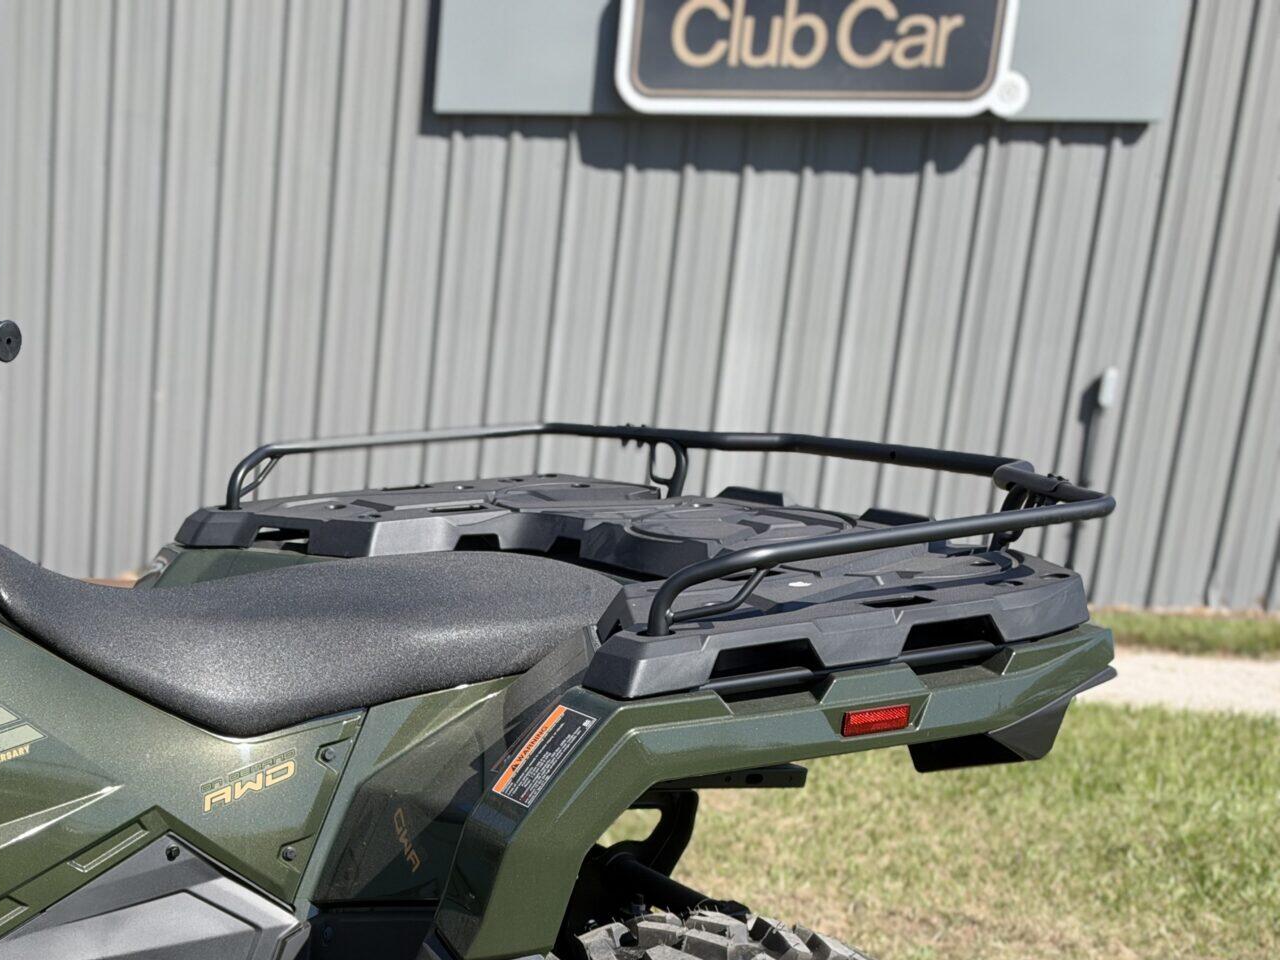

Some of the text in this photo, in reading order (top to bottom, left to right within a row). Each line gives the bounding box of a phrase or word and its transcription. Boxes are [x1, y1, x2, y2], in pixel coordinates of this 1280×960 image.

[671, 0, 964, 69] Club Car
[517, 725, 549, 764] WARNING
[204, 760, 296, 813] AWD
